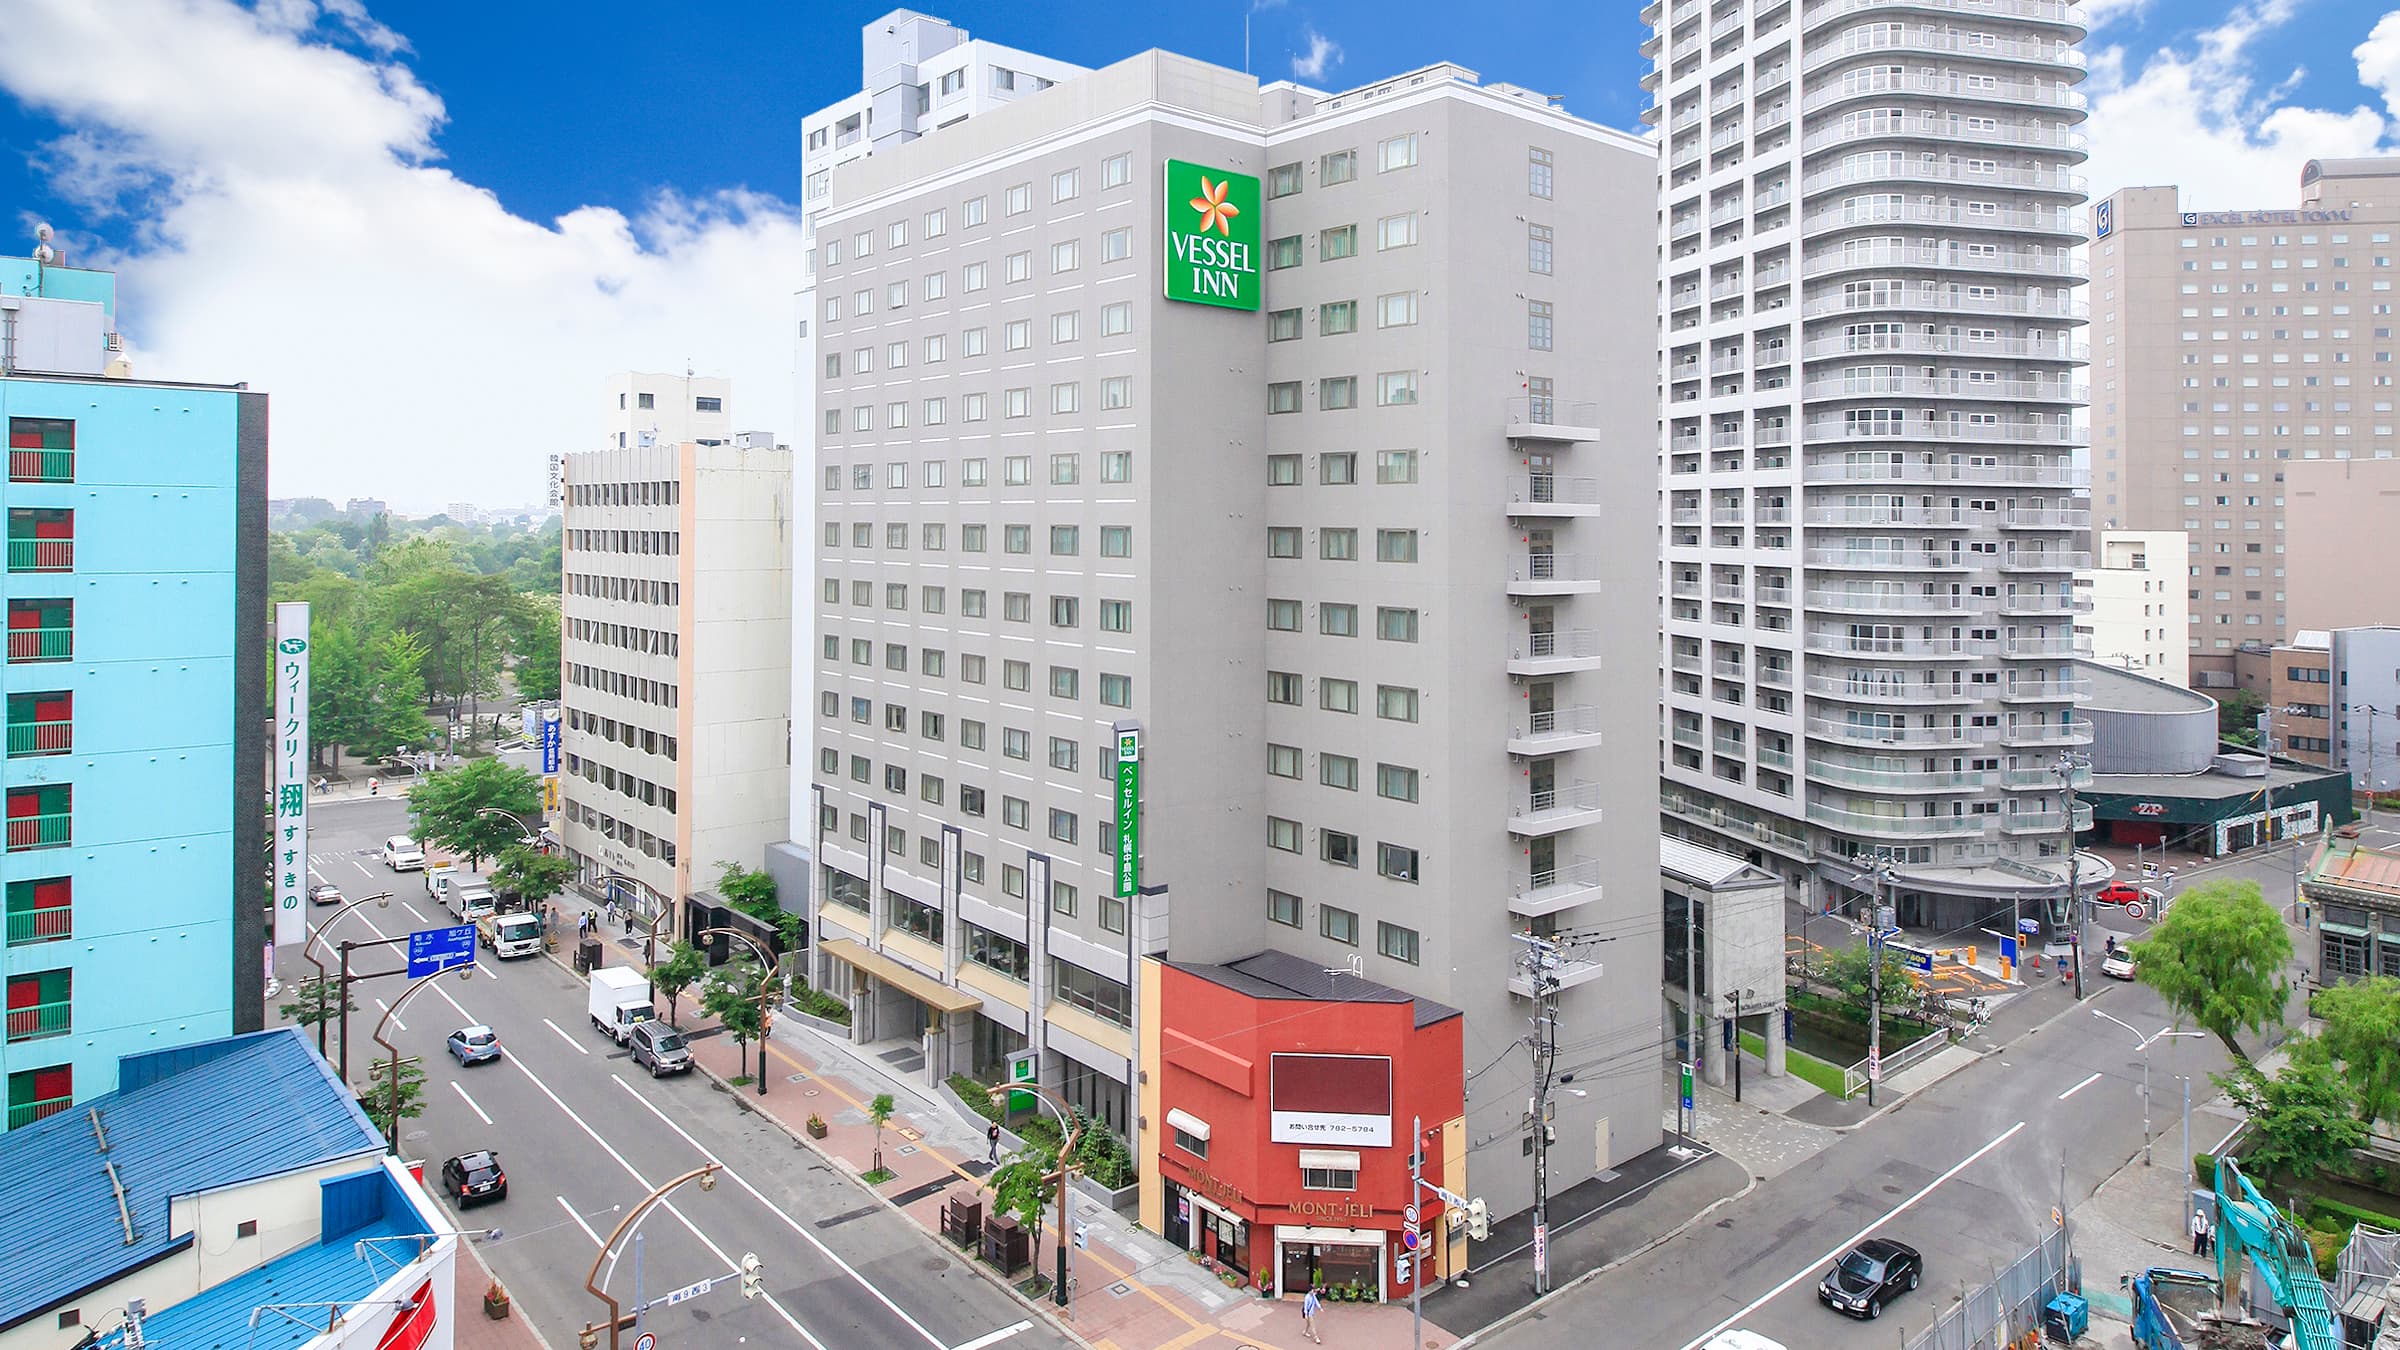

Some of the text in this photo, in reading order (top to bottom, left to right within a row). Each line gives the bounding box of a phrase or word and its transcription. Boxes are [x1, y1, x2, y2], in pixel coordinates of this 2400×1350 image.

[2201, 210, 2352, 225] EXCEL HOTEL TOKYU
[1171, 230, 1256, 273] VESSEL
[1192, 267, 1239, 299] INN
